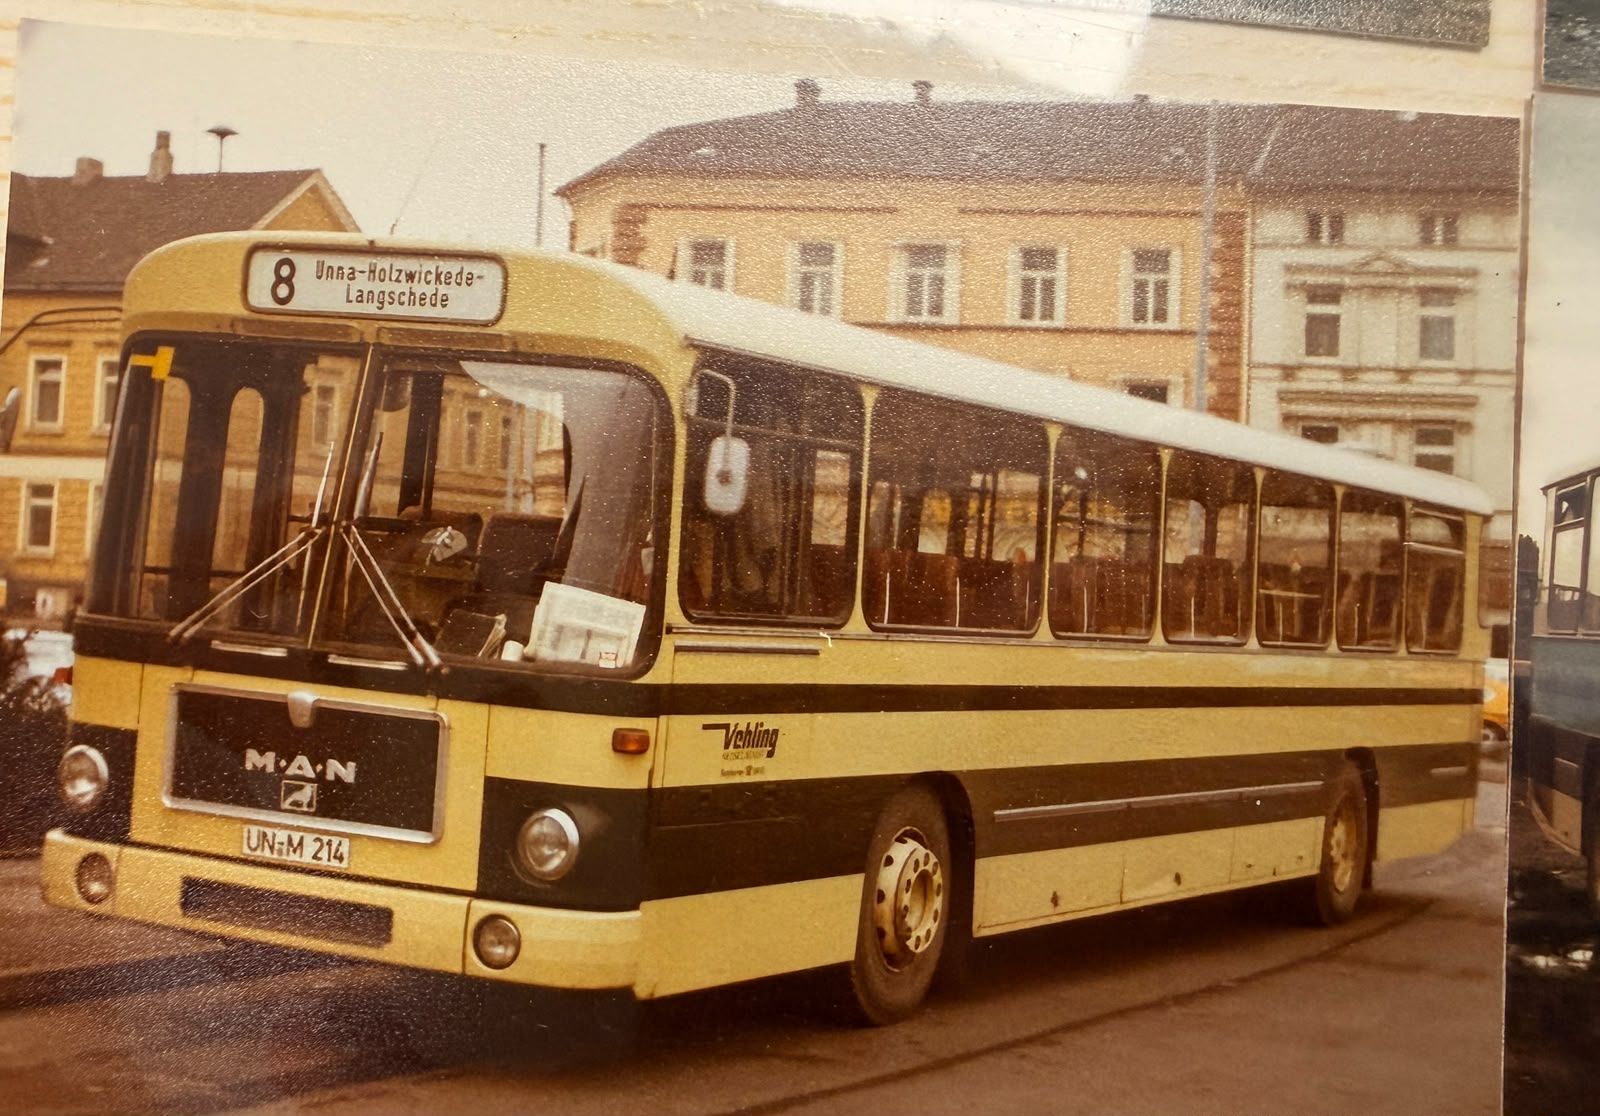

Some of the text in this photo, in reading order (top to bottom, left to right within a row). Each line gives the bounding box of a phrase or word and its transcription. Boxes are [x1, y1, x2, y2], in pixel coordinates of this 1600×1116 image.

[271, 257, 296, 305] 8
[346, 284, 449, 310] Langschede
[702, 722, 779, 758] Vehling
[312, 837, 345, 864] 214
